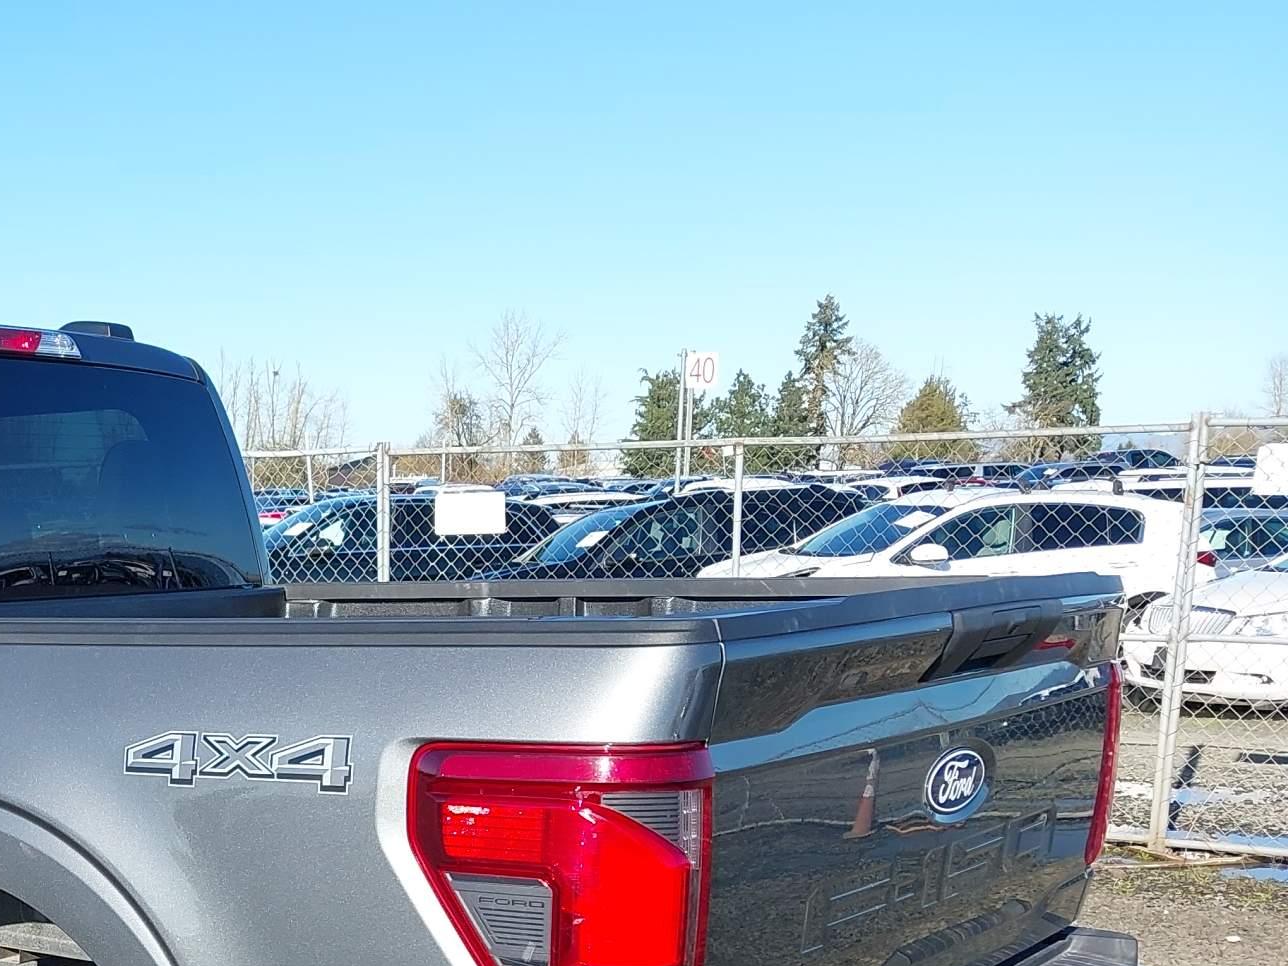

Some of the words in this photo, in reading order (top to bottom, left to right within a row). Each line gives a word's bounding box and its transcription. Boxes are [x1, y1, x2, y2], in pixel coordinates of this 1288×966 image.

[689, 357, 715, 384] 40
[124, 731, 354, 795] 4X4
[938, 758, 978, 805] Ford
[478, 896, 545, 909] FORD
